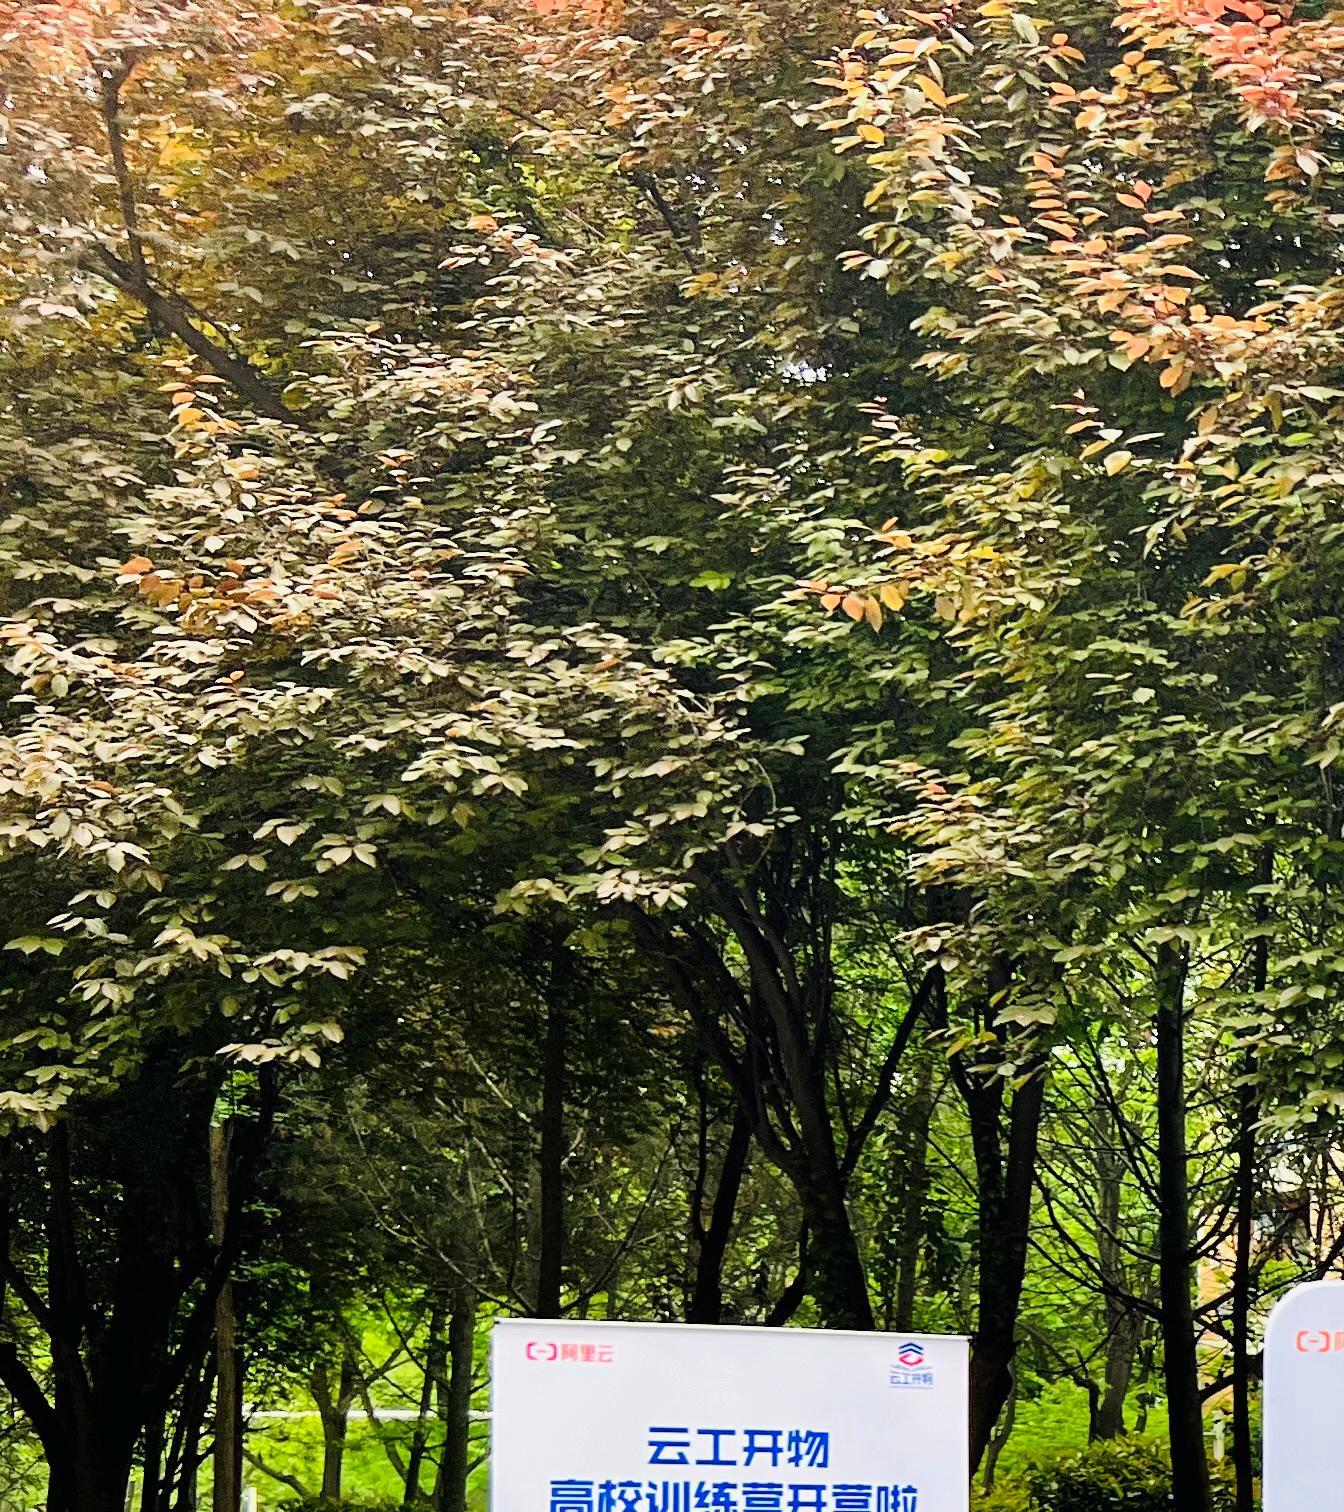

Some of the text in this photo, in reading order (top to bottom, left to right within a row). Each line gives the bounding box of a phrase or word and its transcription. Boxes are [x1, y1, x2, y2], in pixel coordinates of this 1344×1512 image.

[561, 1343, 614, 1363] 阿里云
[647, 1426, 830, 1469] 云工开物
